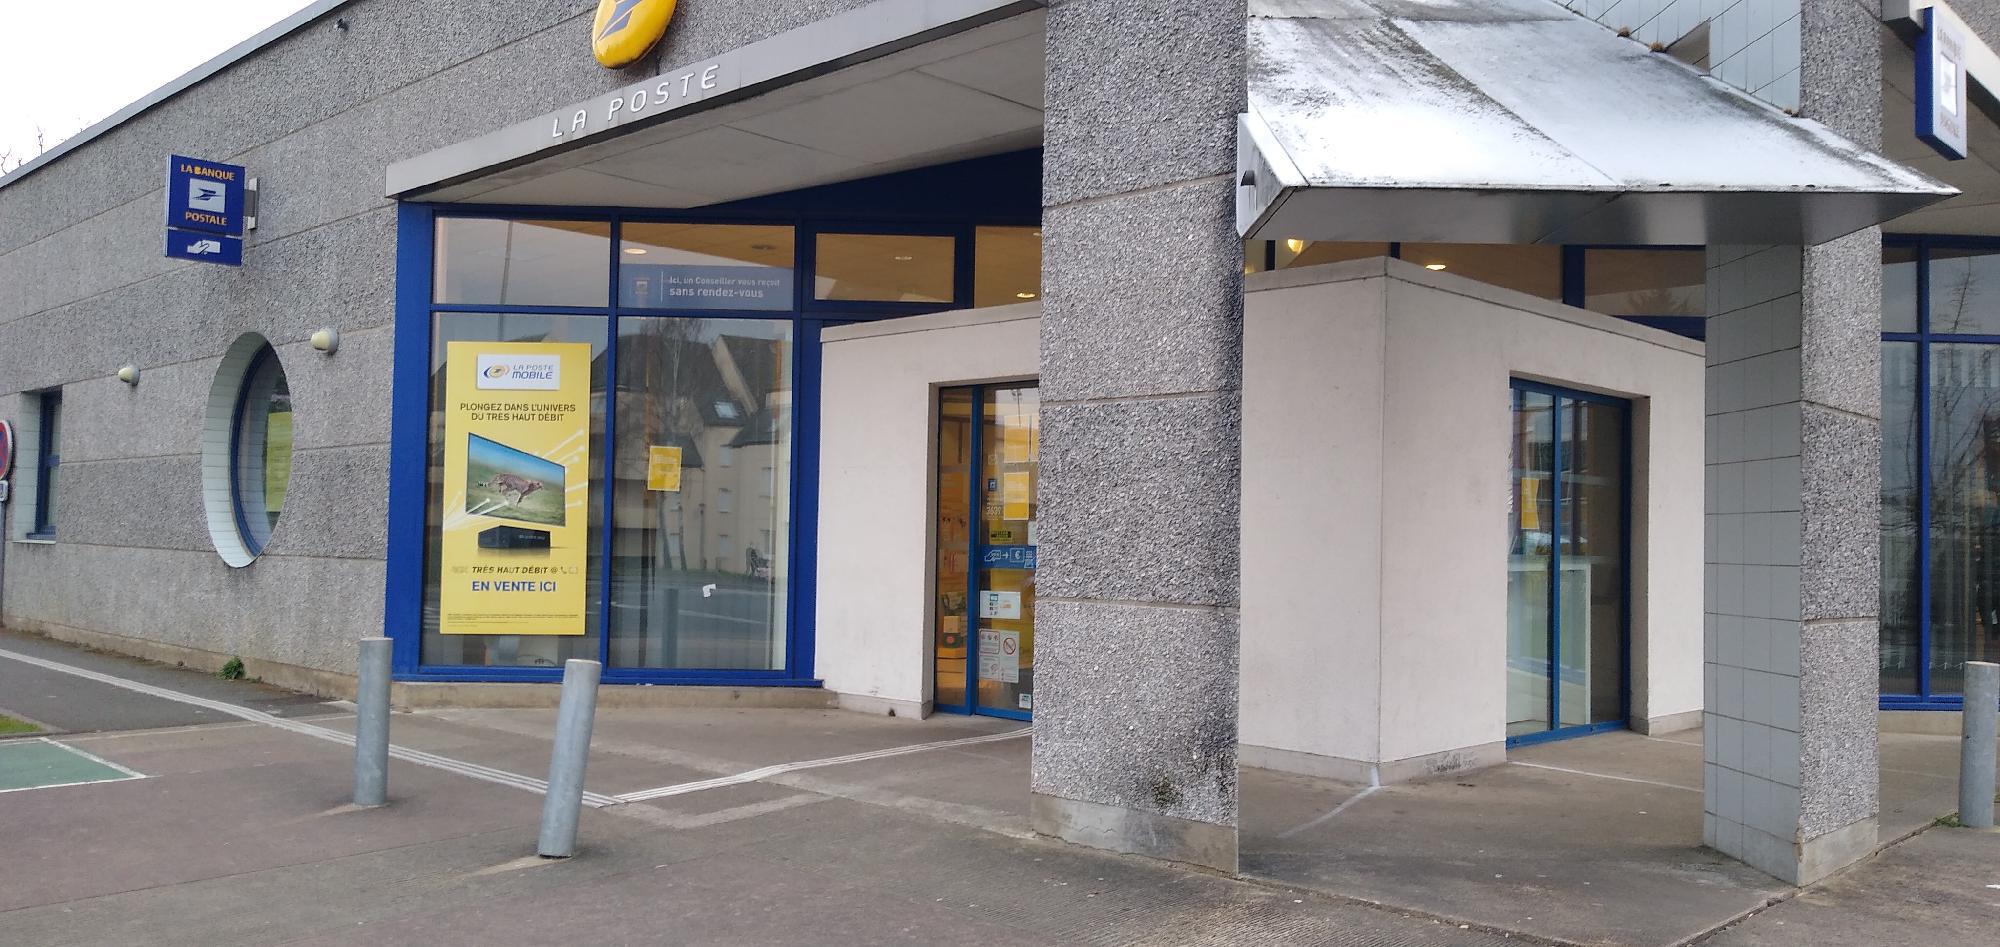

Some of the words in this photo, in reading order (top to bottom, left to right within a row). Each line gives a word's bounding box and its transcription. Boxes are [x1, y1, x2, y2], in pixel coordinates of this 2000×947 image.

[552, 109, 588, 138] LA
[608, 64, 720, 121] POSTE
[181, 164, 193, 174] LA
[194, 166, 236, 181] BANQUE
[185, 211, 228, 226] POSTALE
[695, 276, 736, 286] Conseiller
[738, 279, 756, 287] vous
[669, 287, 694, 296] sans
[697, 287, 764, 298] rendez-vous
[512, 371, 553, 380] MOBILE
[460, 402, 502, 411] PLONGEZ
[504, 403, 529, 412] DANS
[531, 403, 576, 412] L'UNIVERS
[471, 412, 484, 421] DU
[512, 413, 535, 422] HAUT
[538, 411, 565, 422] DÉBIT
[497, 566, 520, 574] HAUT
[472, 581, 490, 592] EN
[494, 581, 536, 592] VENTE
[540, 581, 556, 592] ICI
